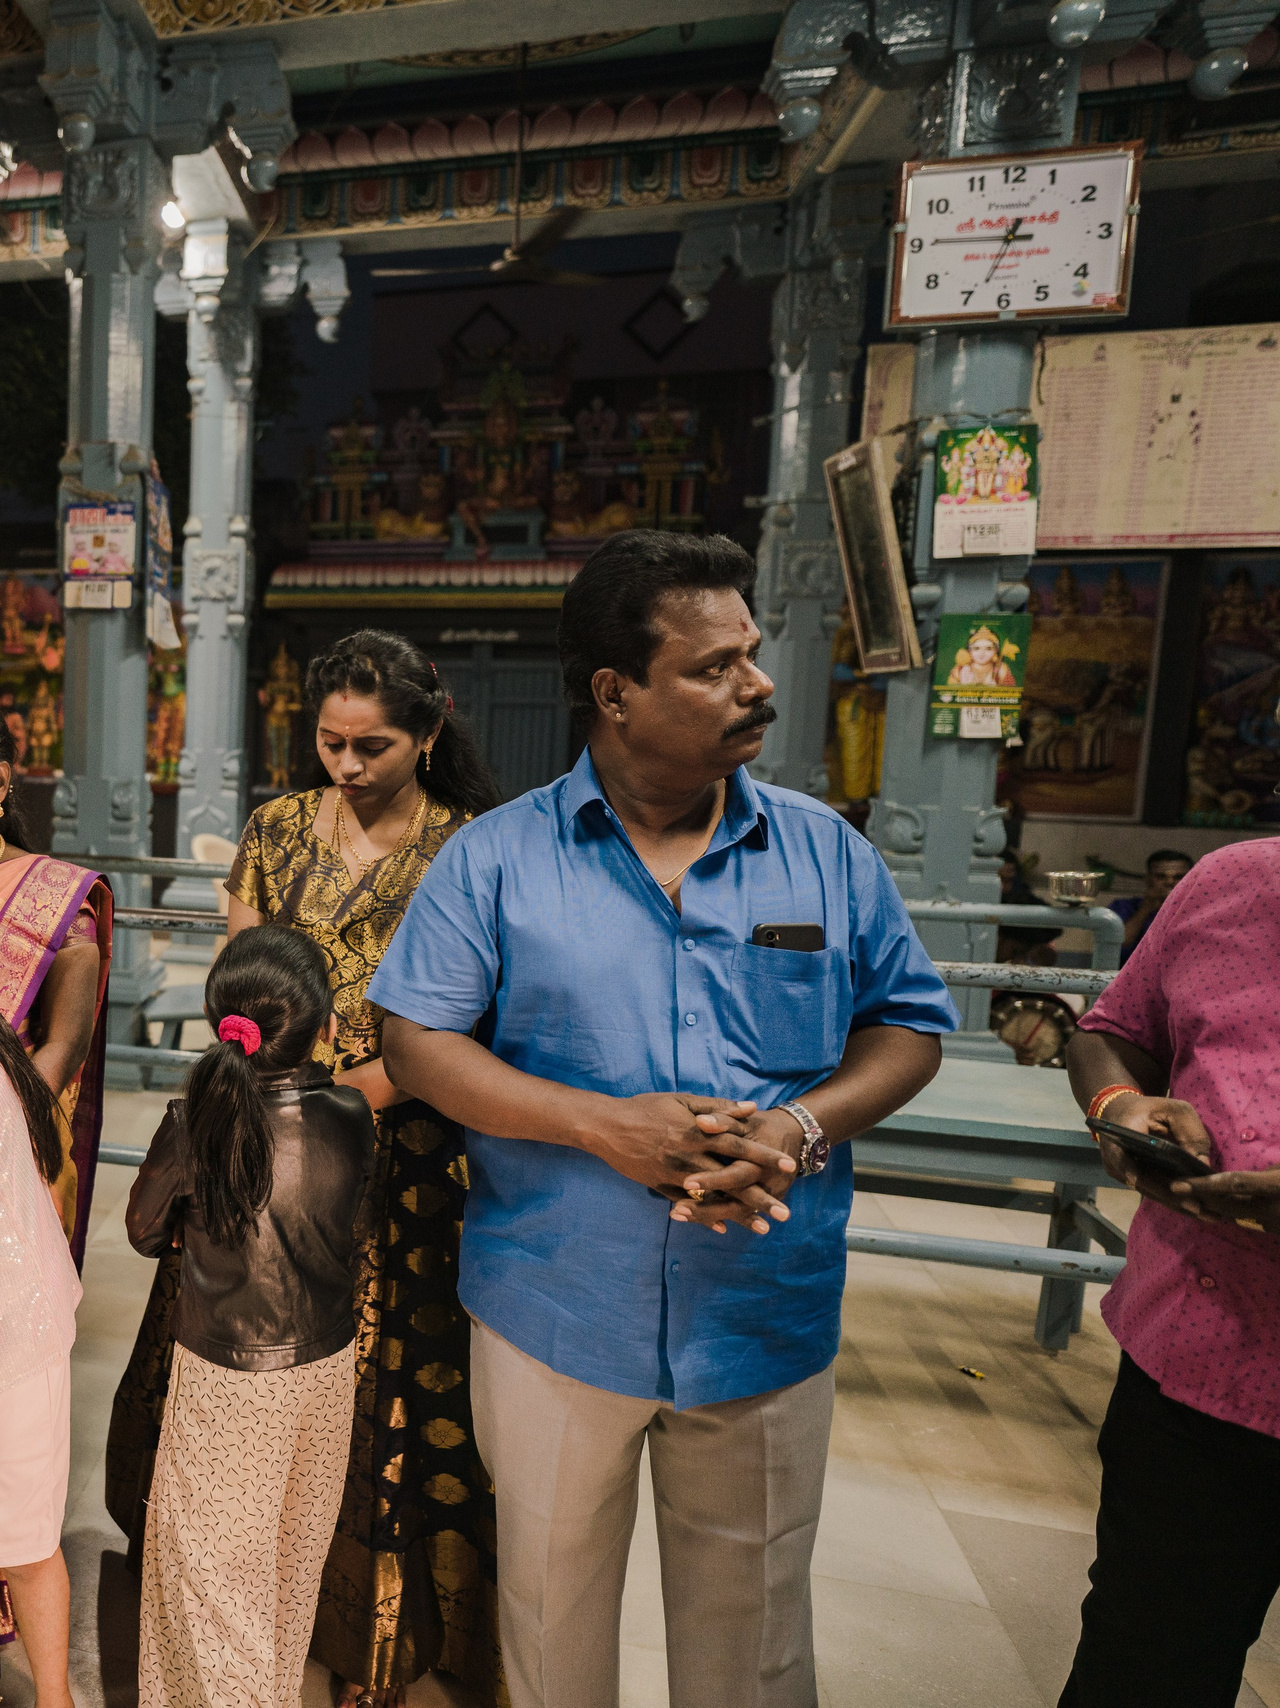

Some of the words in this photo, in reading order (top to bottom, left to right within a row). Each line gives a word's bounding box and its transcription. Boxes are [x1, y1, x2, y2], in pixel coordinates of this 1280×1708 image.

[967, 175, 986, 192] 11
[1003, 166, 1027, 184] 12
[1048, 169, 1057, 185] 1
[1081, 185, 1098, 202] 2
[927, 198, 950, 215] 10
[1098, 222, 1114, 239] 3
[910, 238, 924, 254] 9
[1073, 262, 1089, 279] 4
[926, 273, 939, 289] 8
[960, 290, 974, 306] 7
[996, 292, 1011, 310] 6
[1035, 285, 1050, 302] 5
